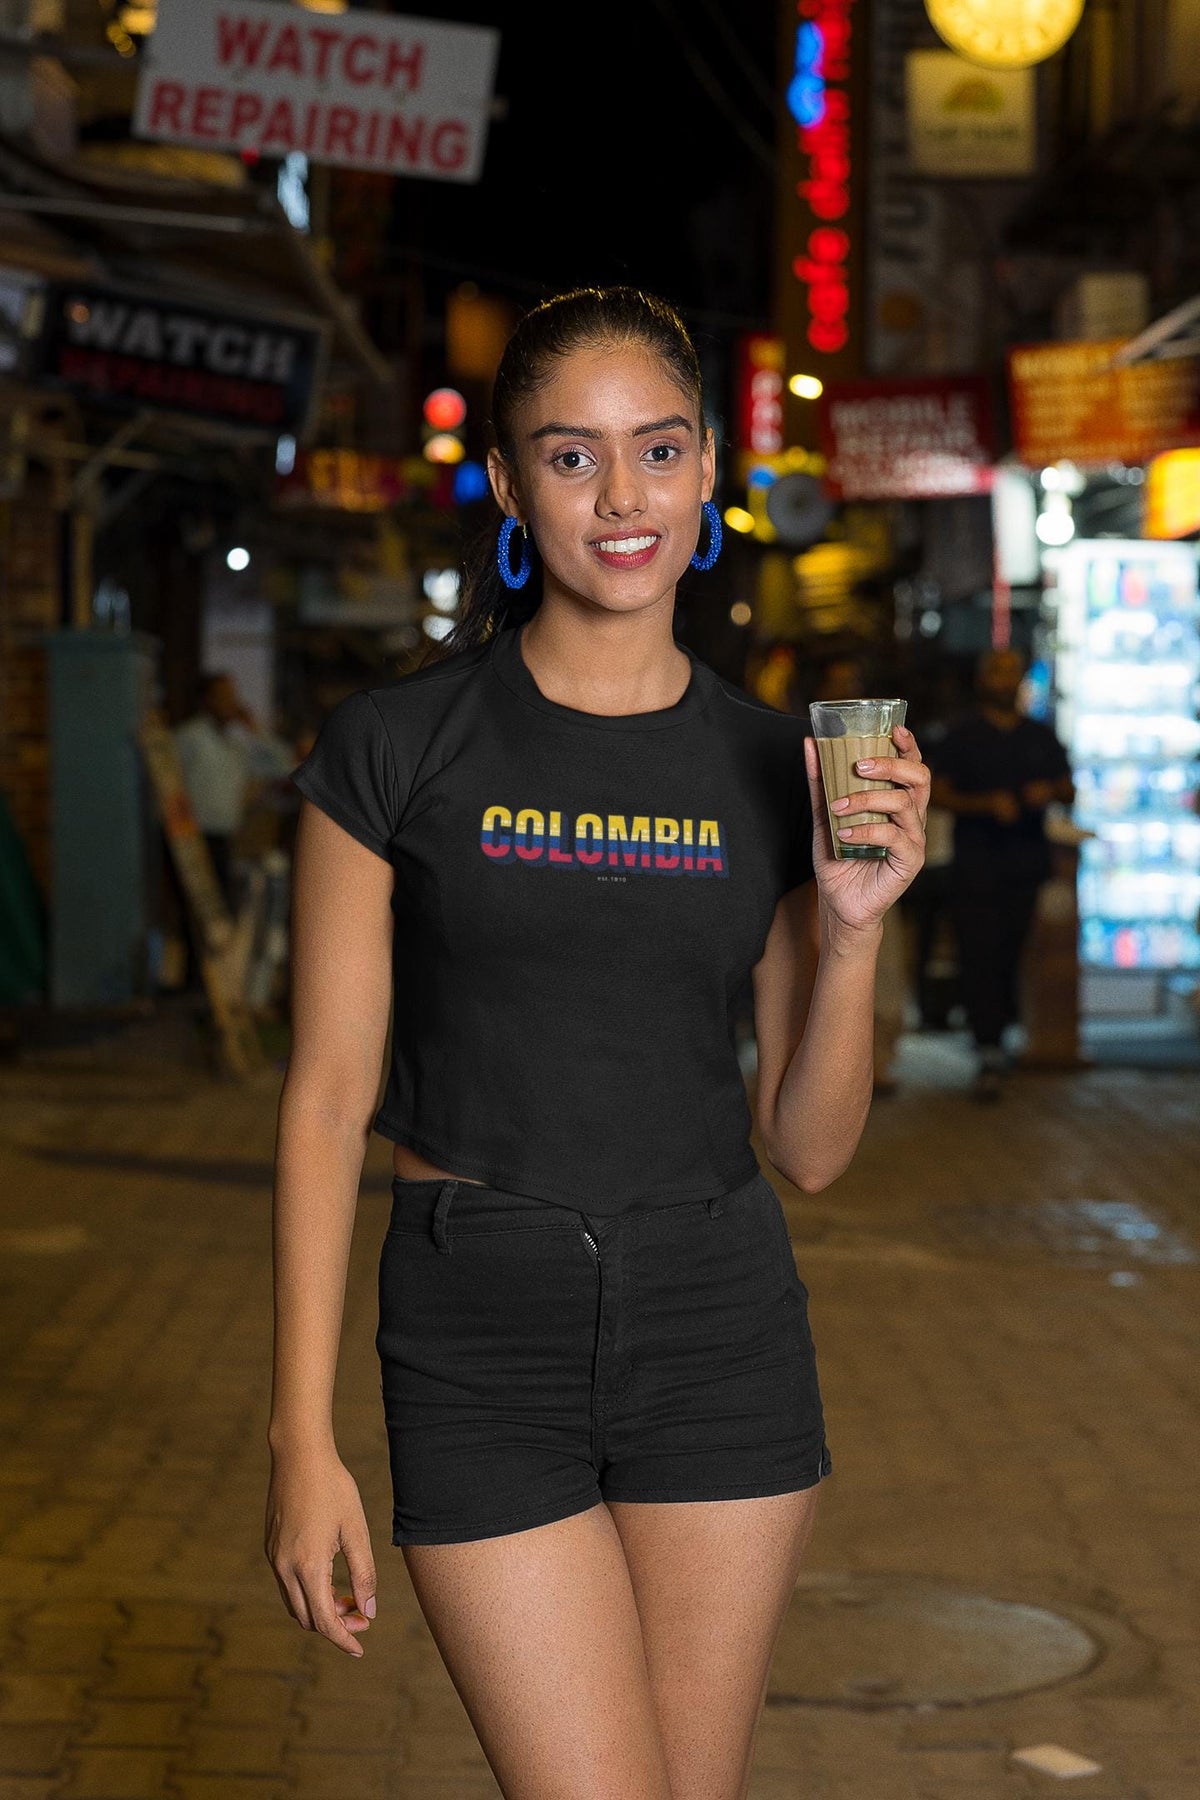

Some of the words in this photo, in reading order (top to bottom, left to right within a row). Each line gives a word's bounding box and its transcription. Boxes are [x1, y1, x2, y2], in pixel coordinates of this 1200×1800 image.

[216, 14, 425, 92] WATCH
[151, 78, 469, 173] REPAIRING
[67, 302, 297, 383] WATCH
[481, 805, 726, 875] COLOMBIA
